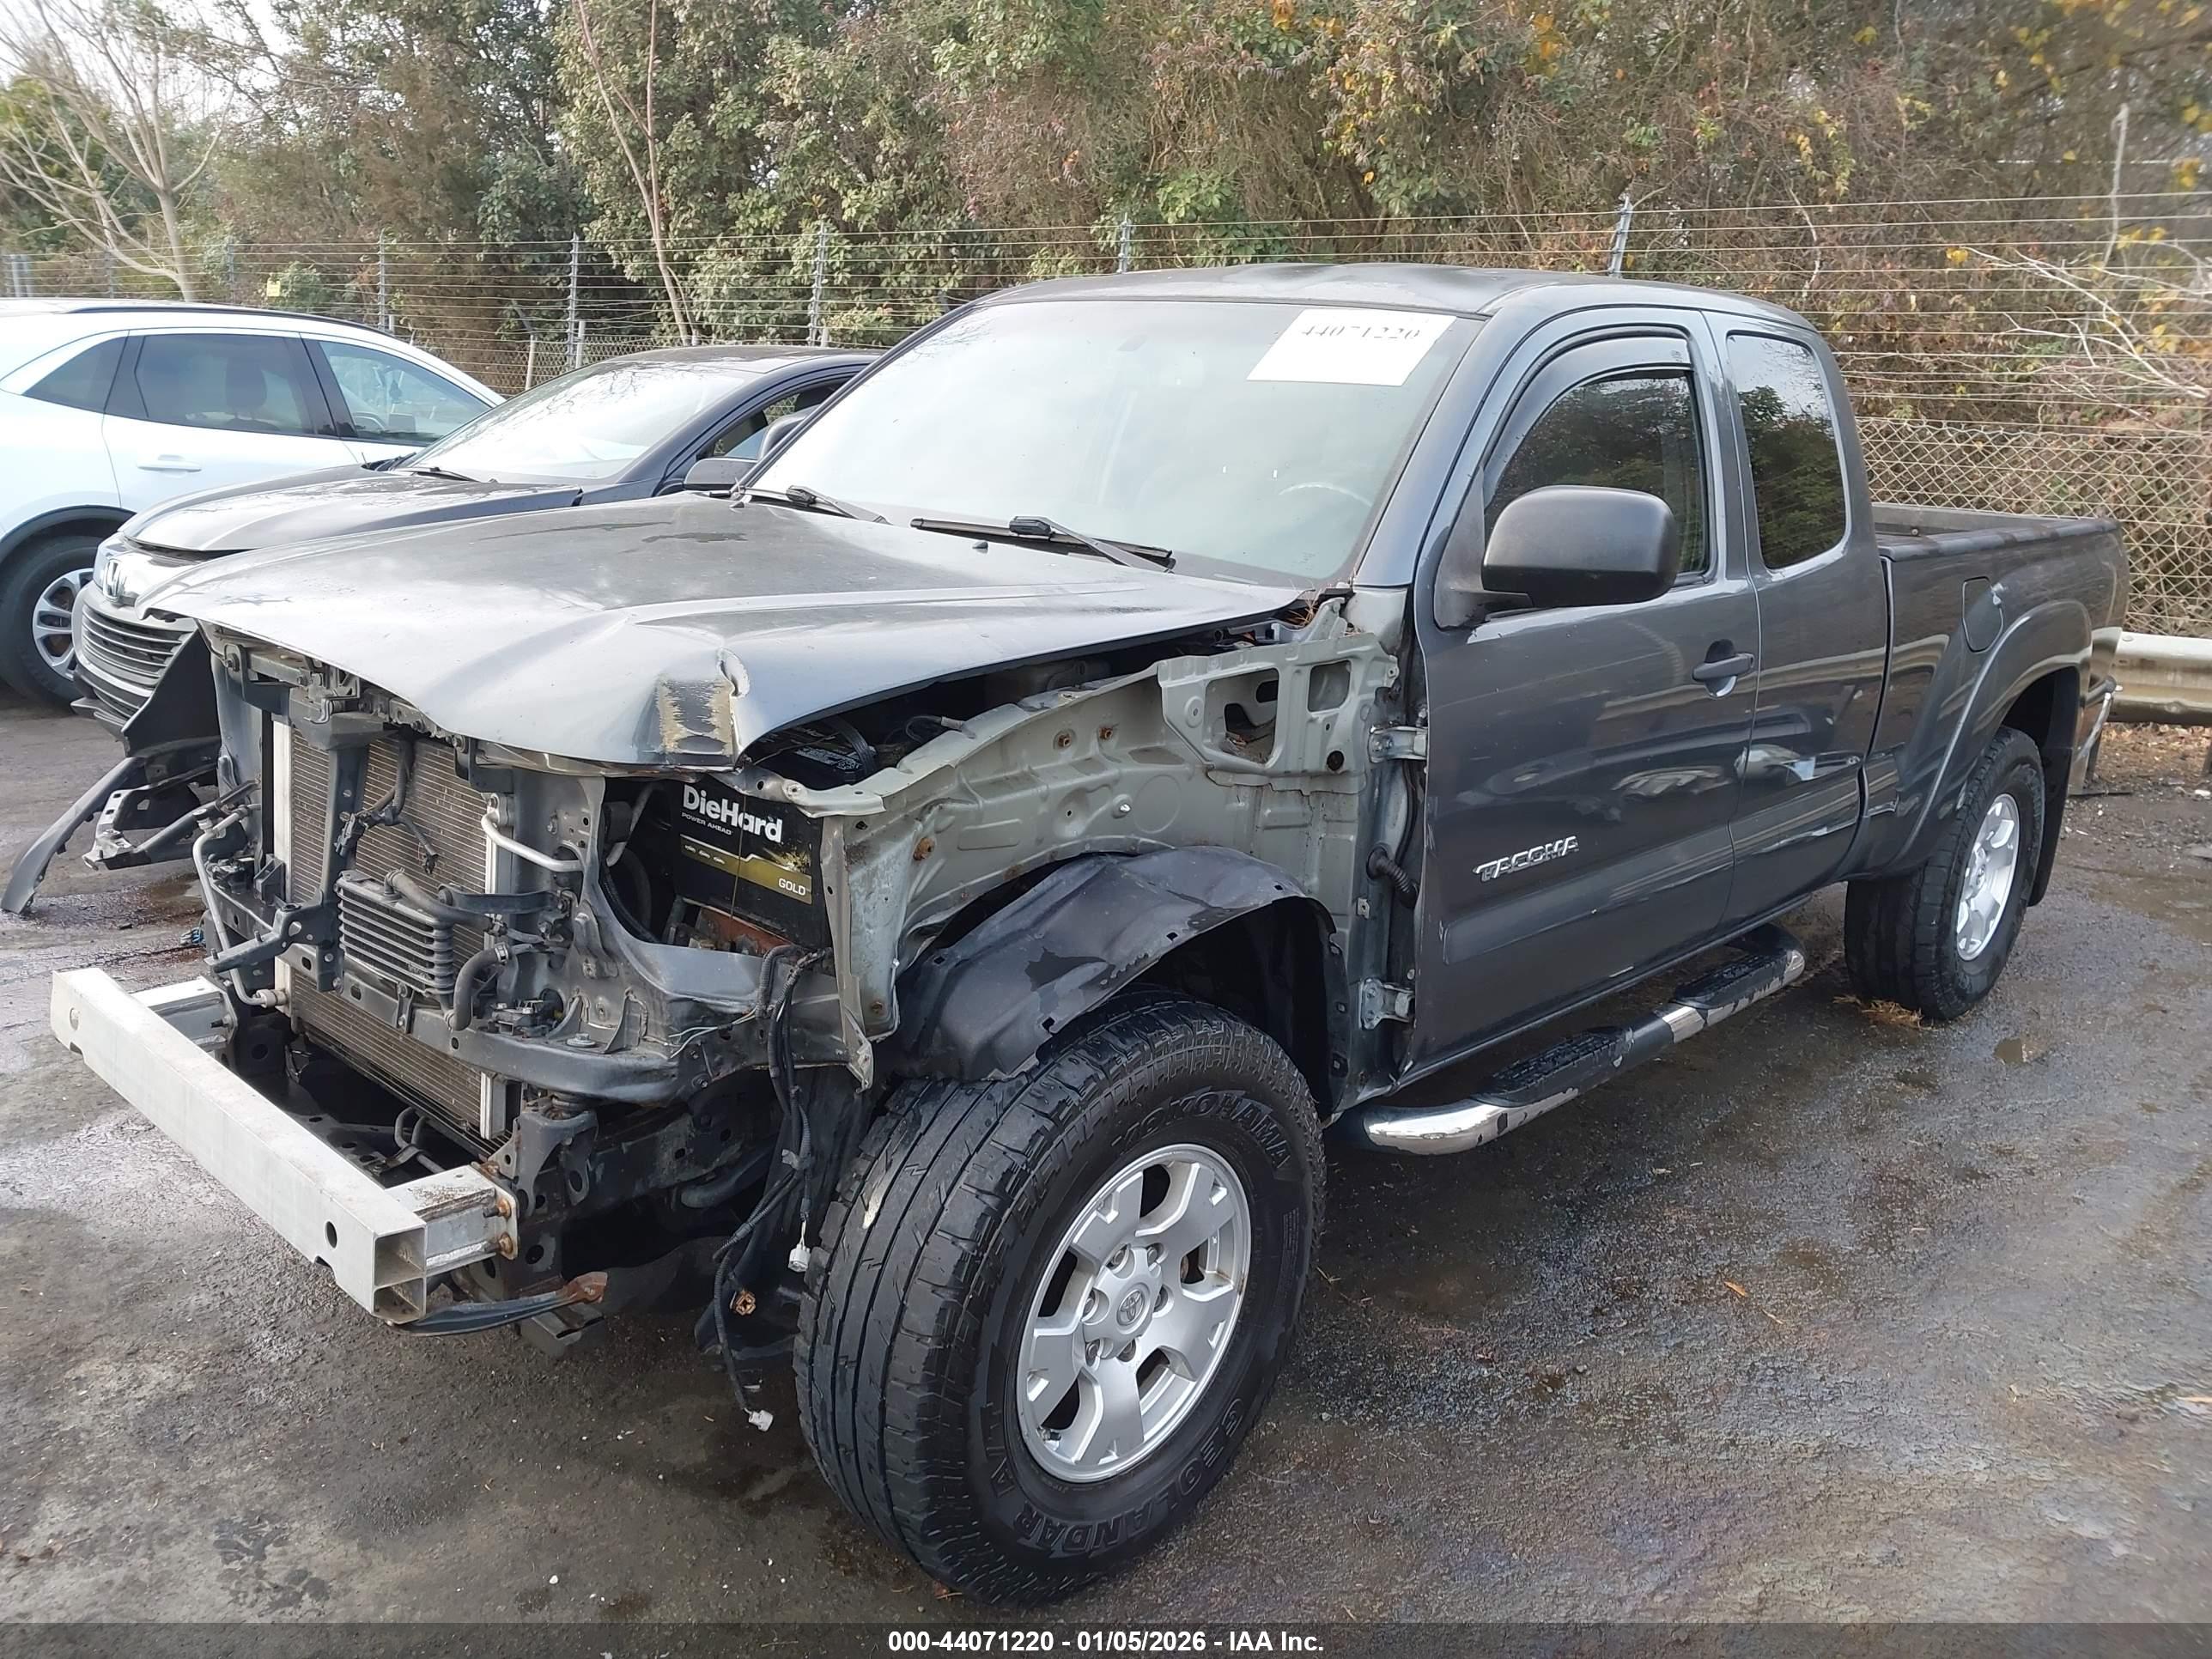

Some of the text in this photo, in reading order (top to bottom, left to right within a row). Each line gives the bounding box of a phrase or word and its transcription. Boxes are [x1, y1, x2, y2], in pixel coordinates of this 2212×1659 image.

[681, 811, 733, 836] POWER AHEAD
[683, 784, 783, 843] DieHard
[1473, 836, 1579, 881] TACOMA
[778, 878, 806, 896] GOLD
